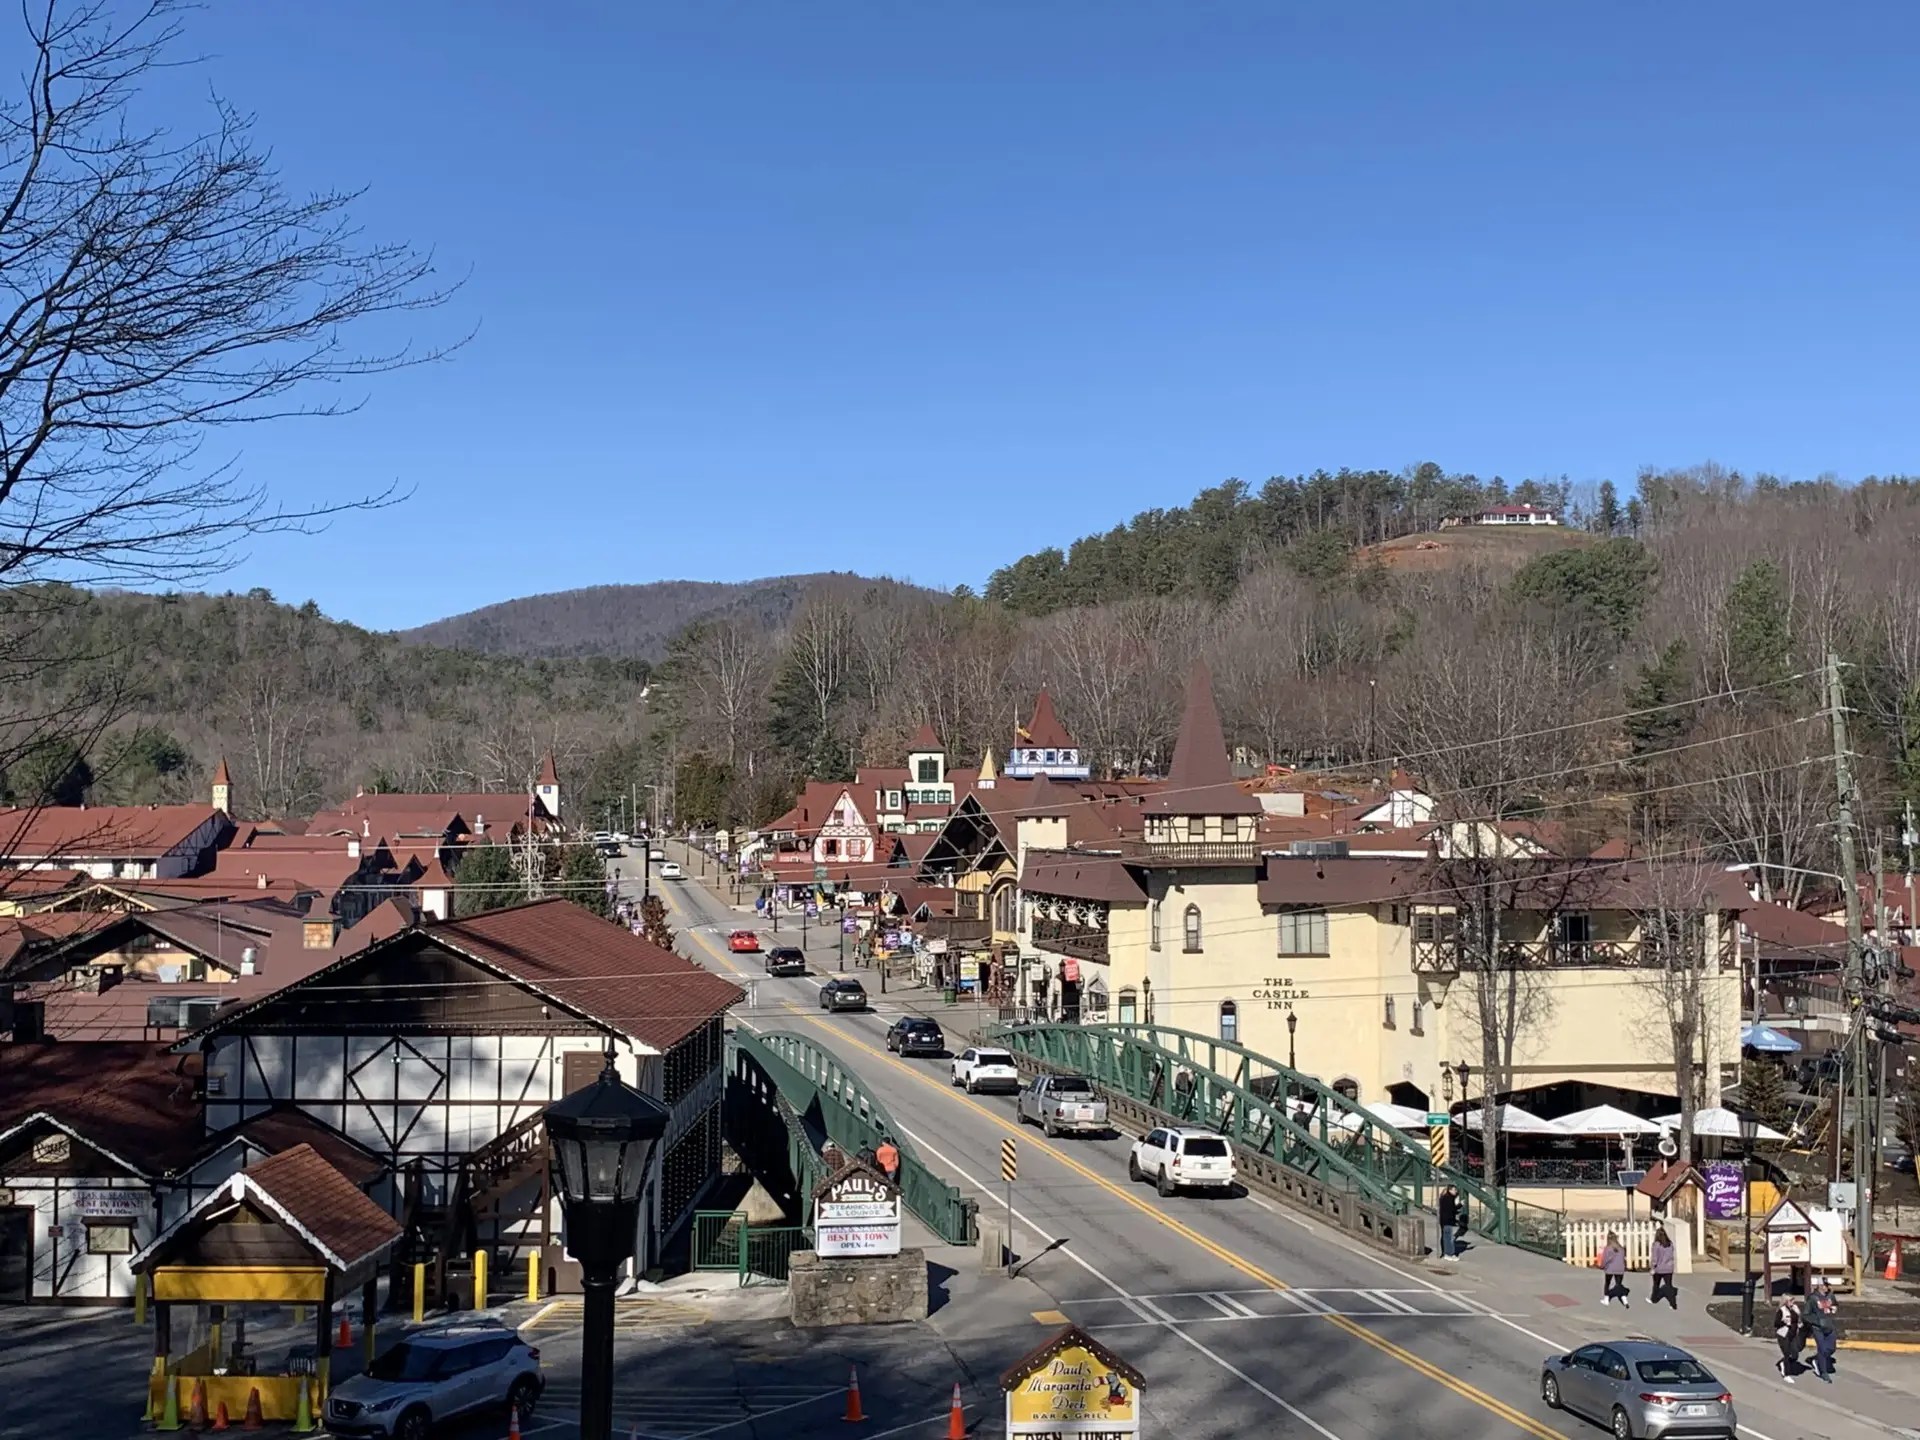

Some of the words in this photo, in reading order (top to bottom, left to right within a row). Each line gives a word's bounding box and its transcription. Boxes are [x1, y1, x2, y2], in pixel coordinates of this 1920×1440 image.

[1264, 978, 1293, 986] THE
[1253, 990, 1309, 999] CASTLE
[1267, 1001, 1293, 1009] INN
[831, 1179, 888, 1201] PAUL'S
[829, 1203, 885, 1211] STEAKHOUSE
[827, 1233, 848, 1241] BEST
[852, 1233, 860, 1241] IN
[865, 1232, 889, 1240] TOWN
[1049, 1359, 1091, 1376] Paul's
[1027, 1377, 1092, 1396] Margarita
[1052, 1396, 1086, 1410] Deck
